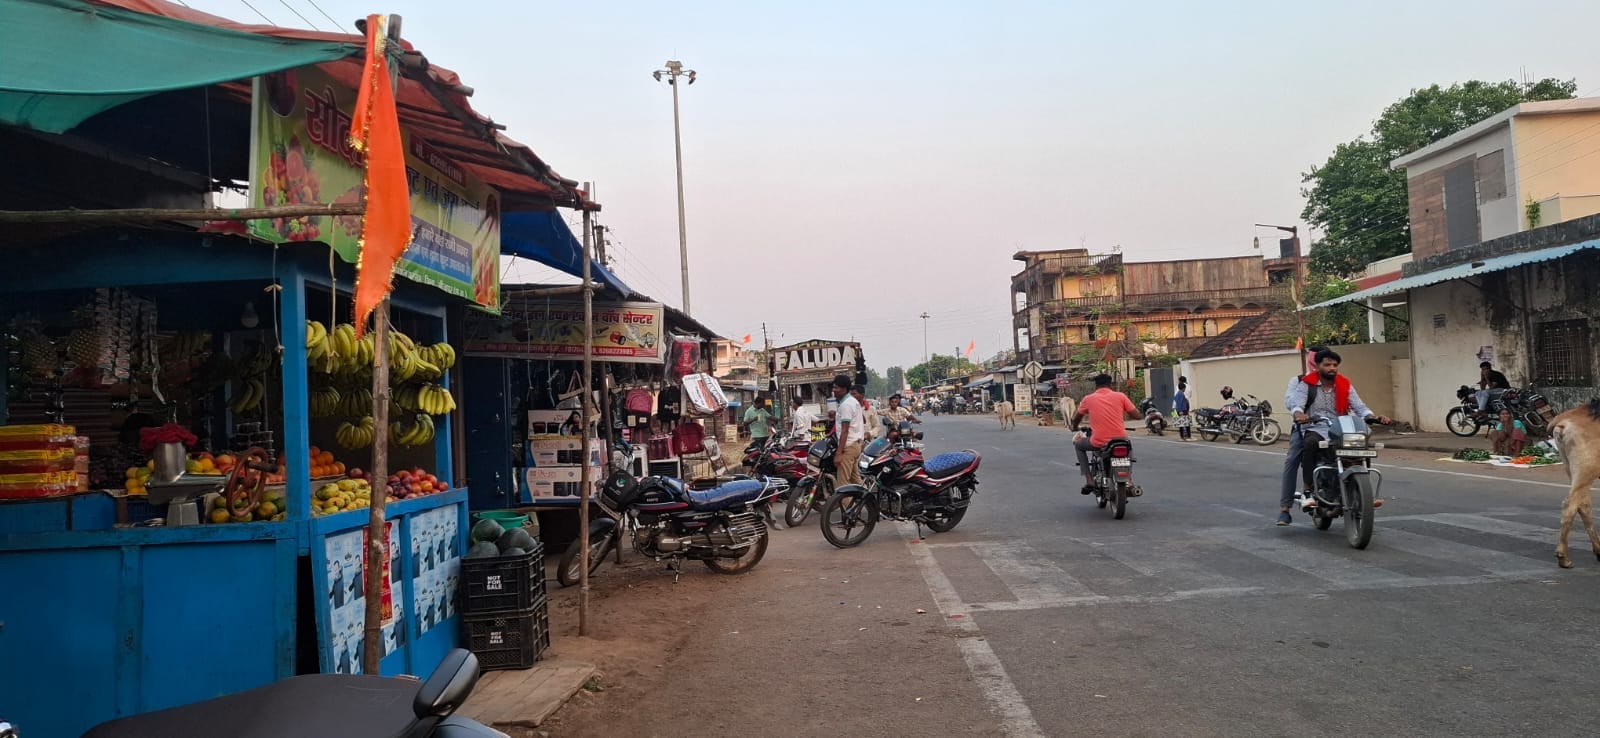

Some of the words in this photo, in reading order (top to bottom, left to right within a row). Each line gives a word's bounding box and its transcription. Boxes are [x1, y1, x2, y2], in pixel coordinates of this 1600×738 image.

[601, 309, 619, 323] वॉच
[623, 311, 654, 324] सेन्टर
[775, 346, 856, 371] FALUDA
